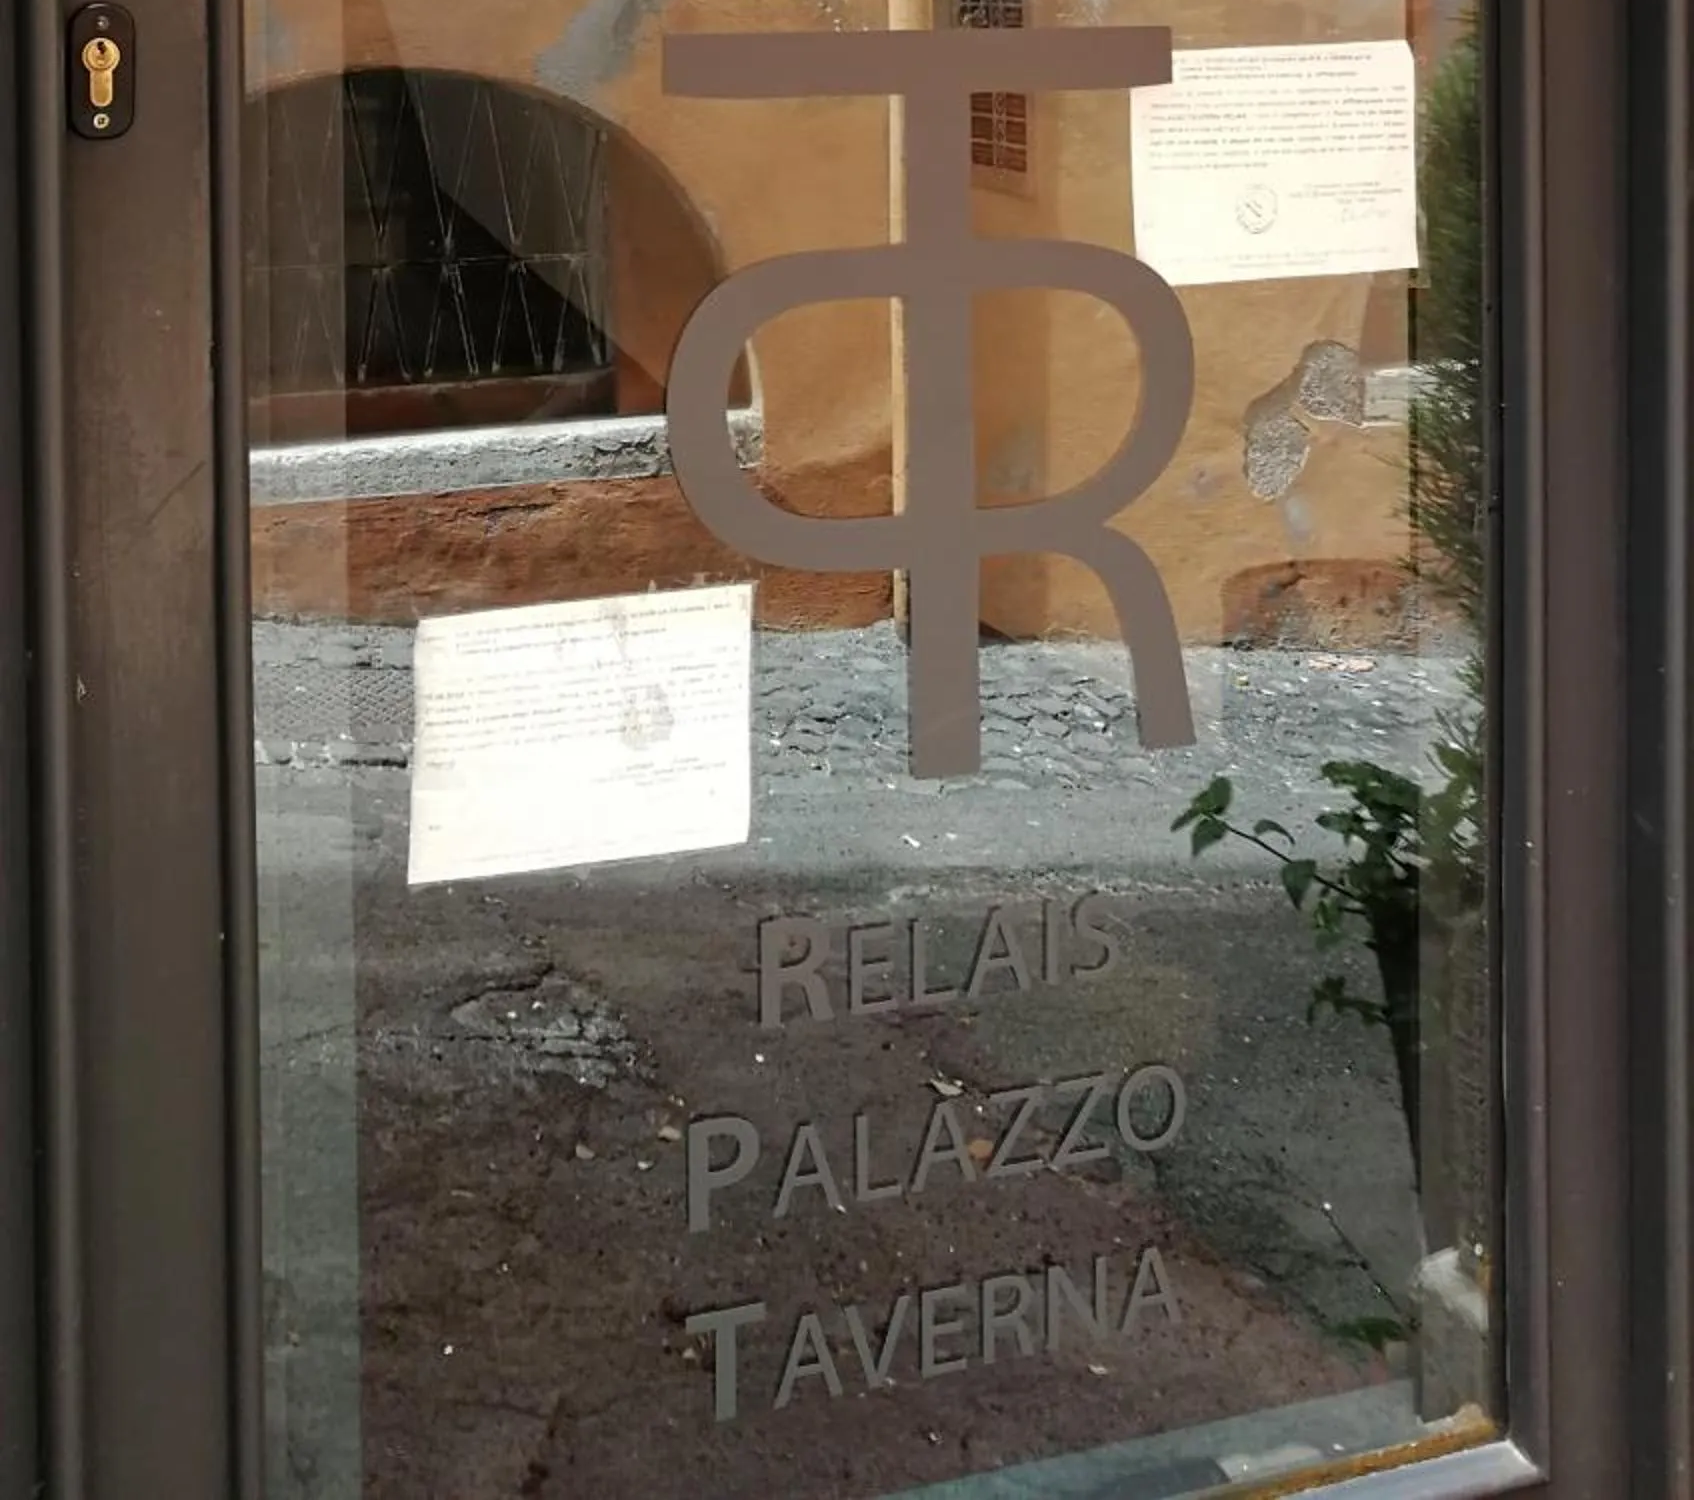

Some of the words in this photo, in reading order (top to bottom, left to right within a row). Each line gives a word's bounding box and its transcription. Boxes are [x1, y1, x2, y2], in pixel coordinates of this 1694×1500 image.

[757, 890, 1119, 1030] RELAIS
[686, 1062, 1188, 1234] PALAZZO
[684, 1245, 1182, 1423] TAVERNA
